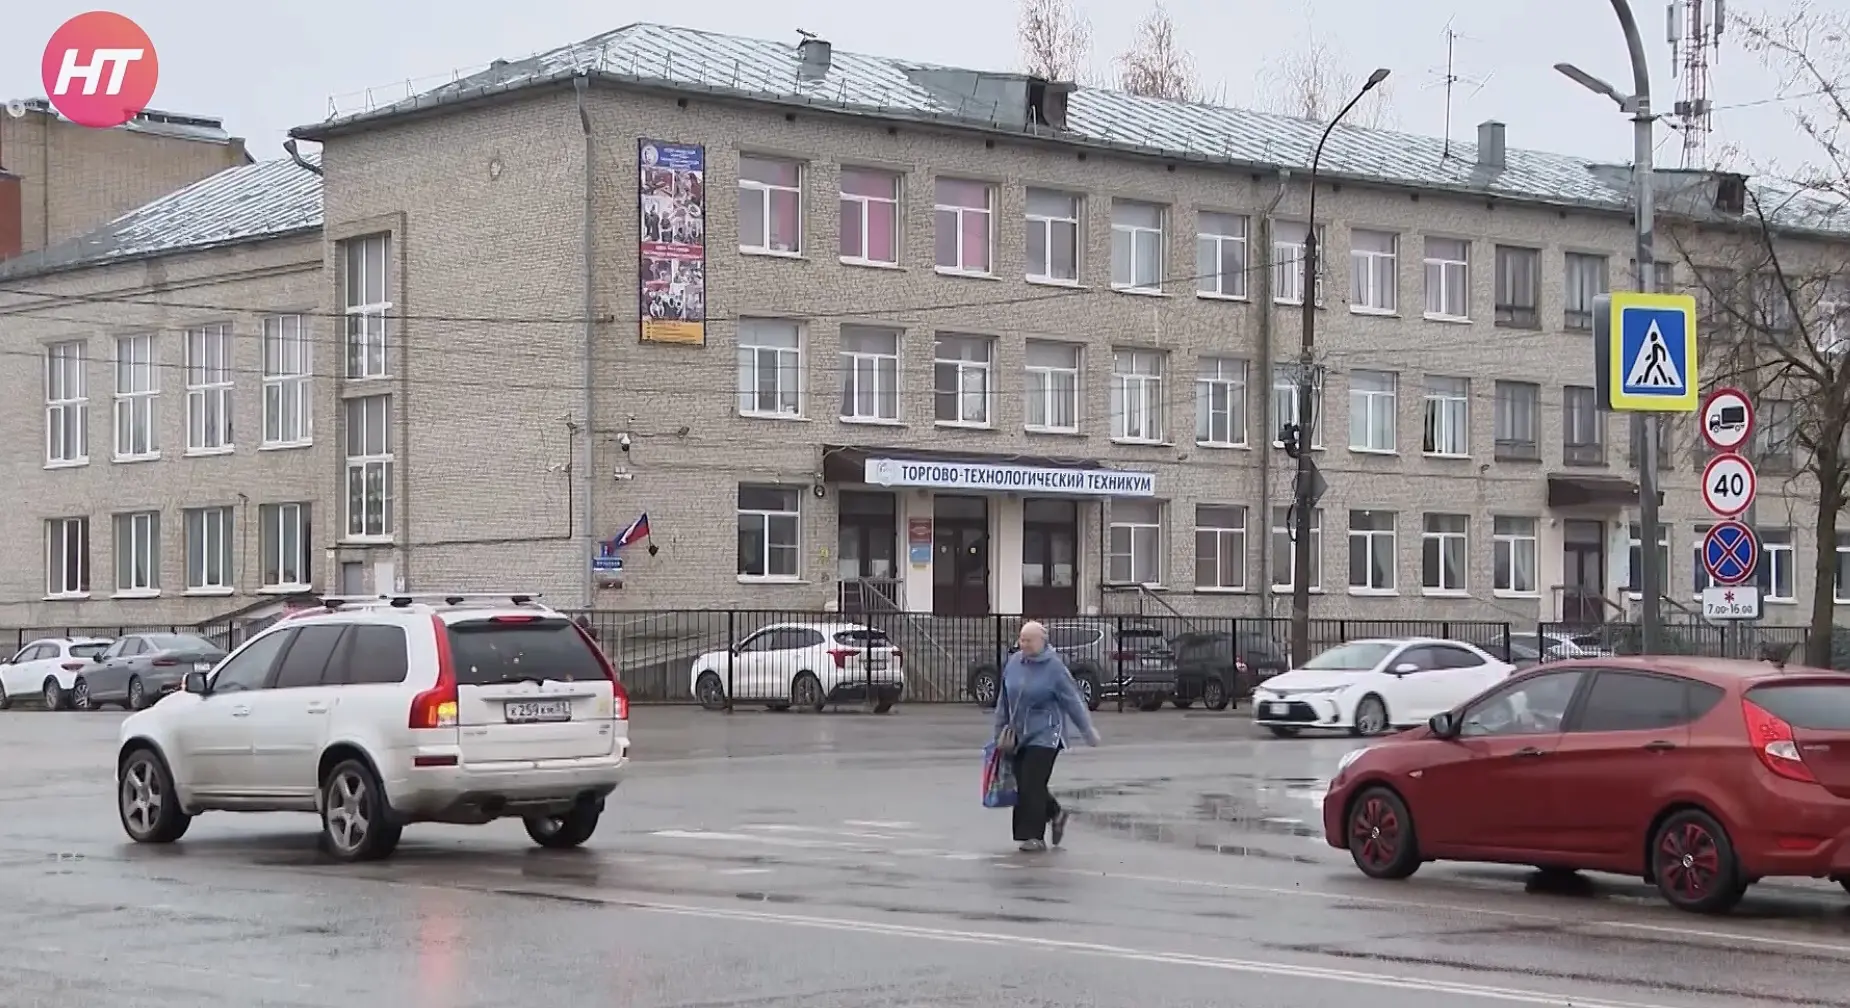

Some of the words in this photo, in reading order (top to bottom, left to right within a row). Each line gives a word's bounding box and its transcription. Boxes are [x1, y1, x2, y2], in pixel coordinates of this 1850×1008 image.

[902, 465, 1083, 488] ТОРГОВО-ТЕХНОЛОГИЧЕСКИЙ
[1088, 473, 1151, 492] ТЕХНИКУМ
[1714, 473, 1743, 497] 40
[1707, 603, 1753, 615] 7.00-16.00
